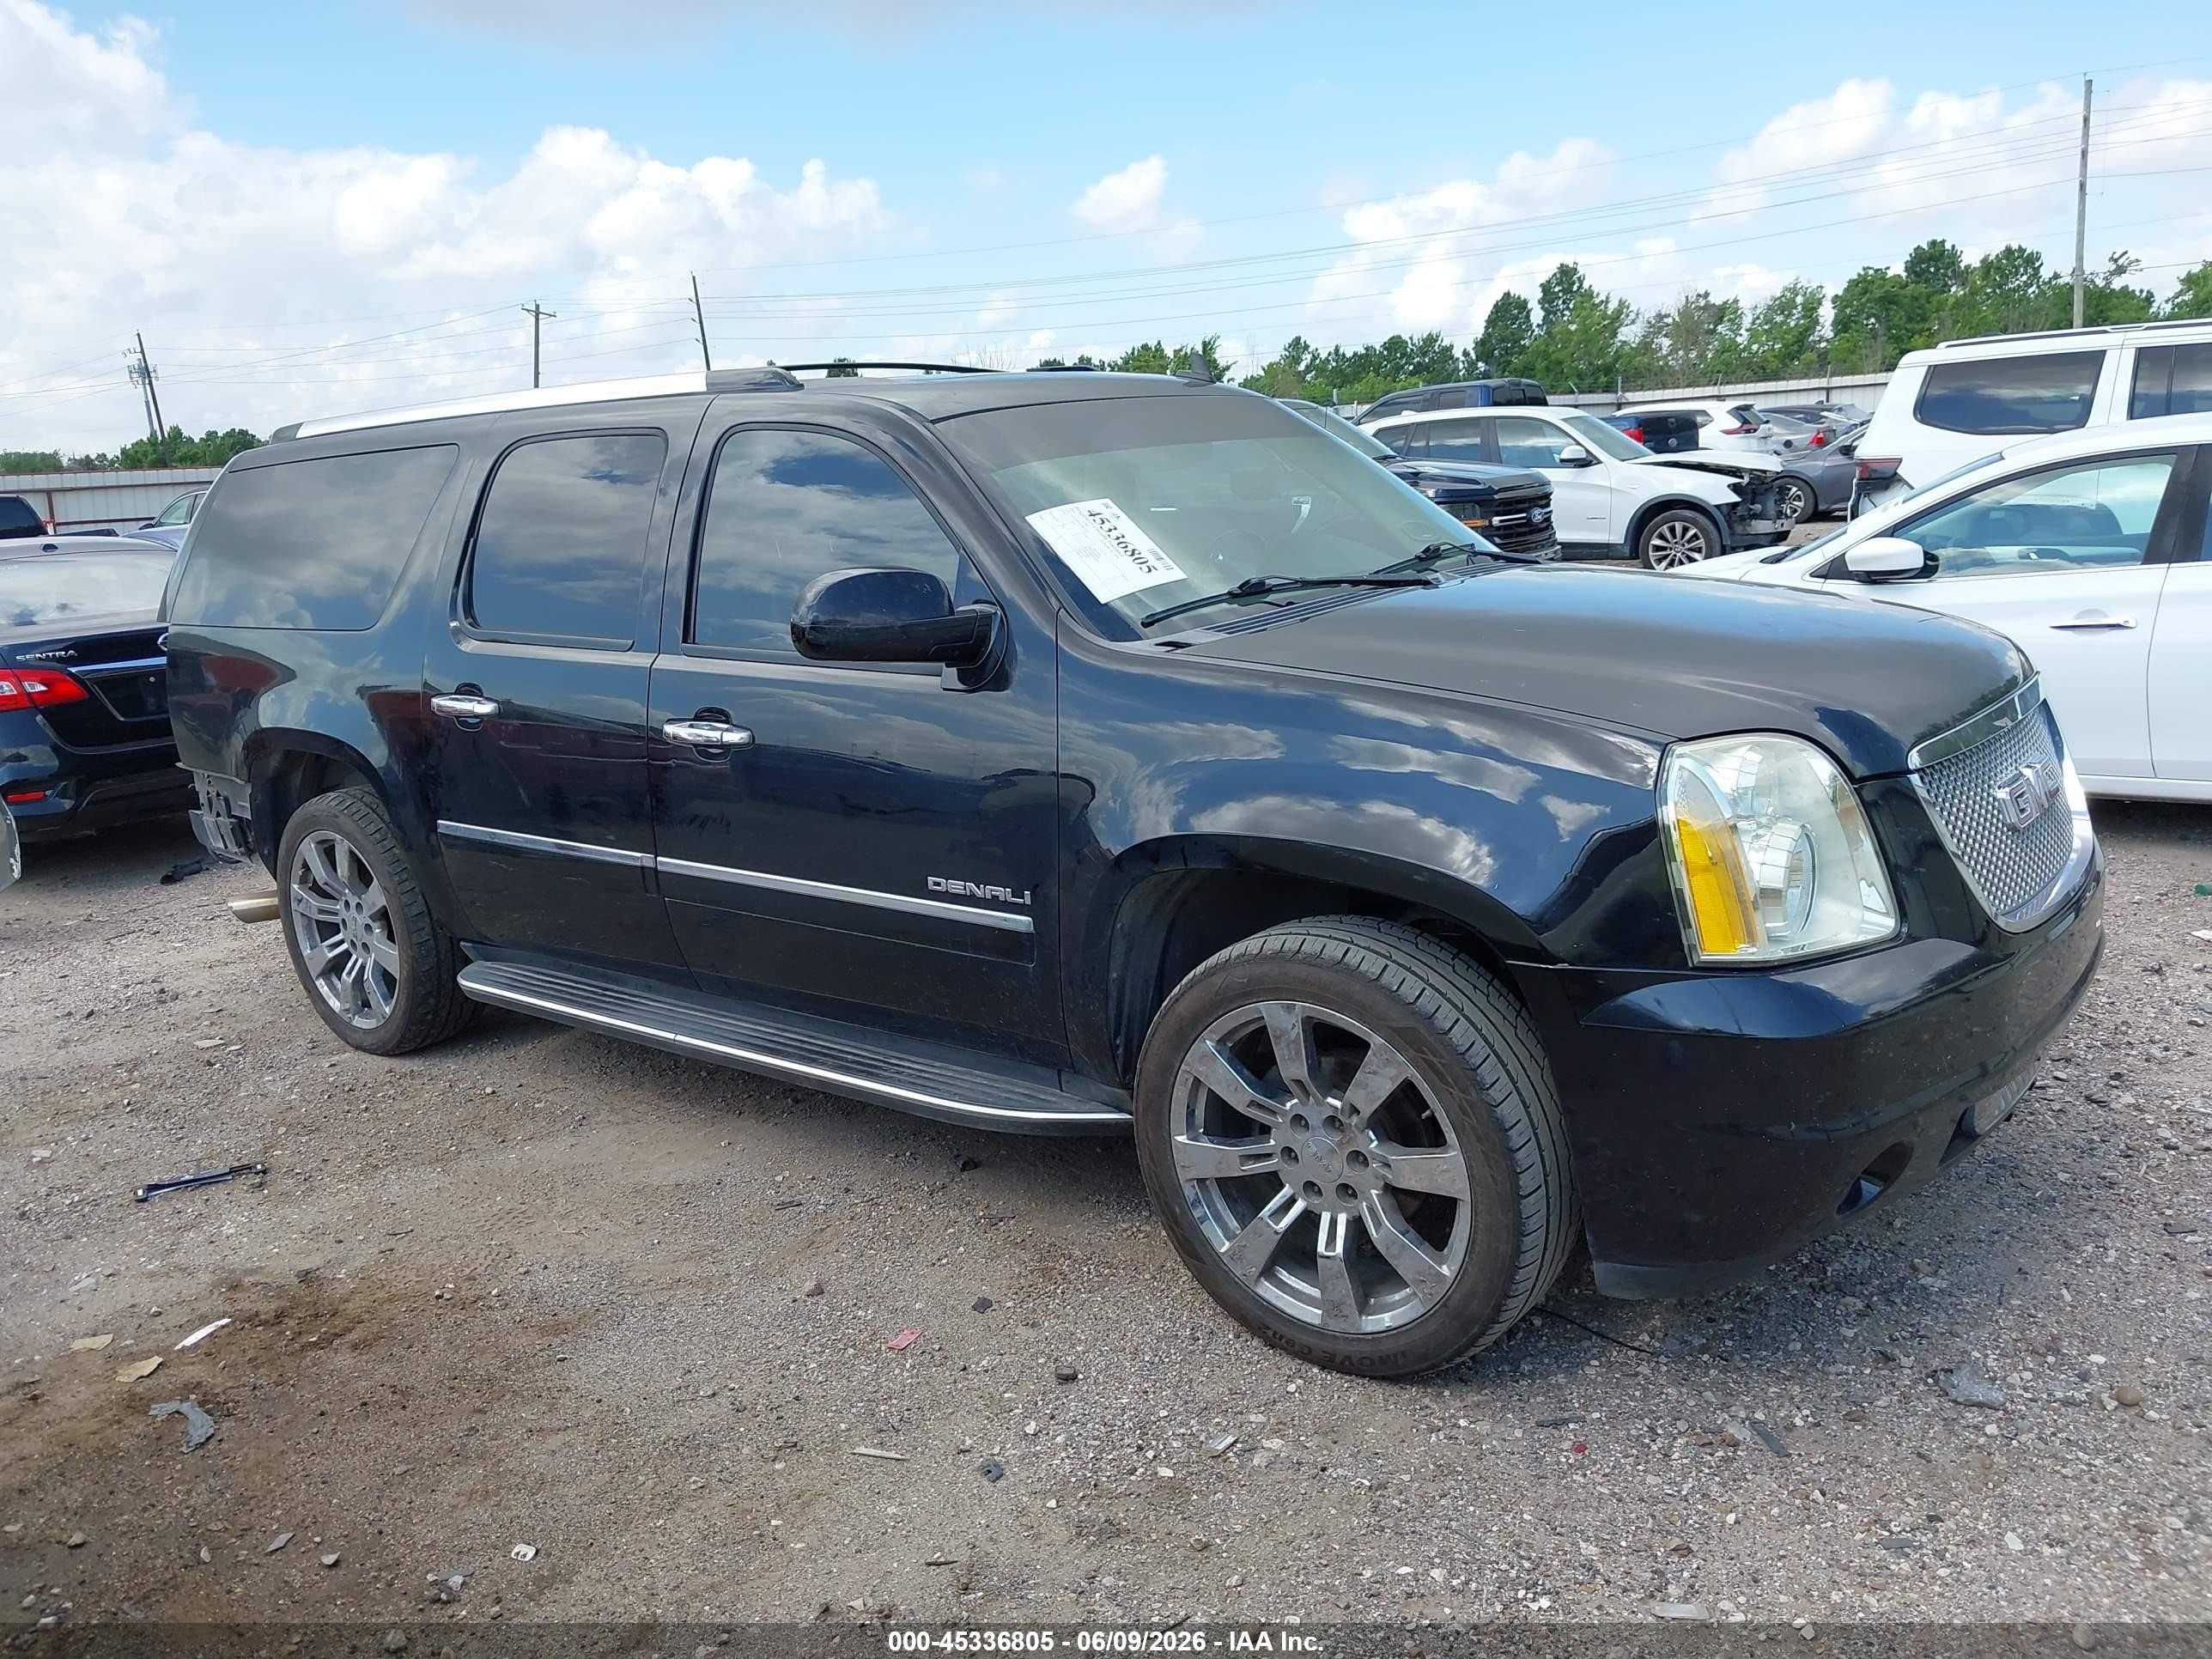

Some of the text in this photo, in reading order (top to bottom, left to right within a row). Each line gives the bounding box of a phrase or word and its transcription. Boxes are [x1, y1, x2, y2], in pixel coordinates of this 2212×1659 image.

[1087, 510, 1159, 574] 45336805
[15, 650, 77, 661] SENTRA
[2001, 757, 2061, 827] GMC
[927, 876, 1031, 905] DENALI
